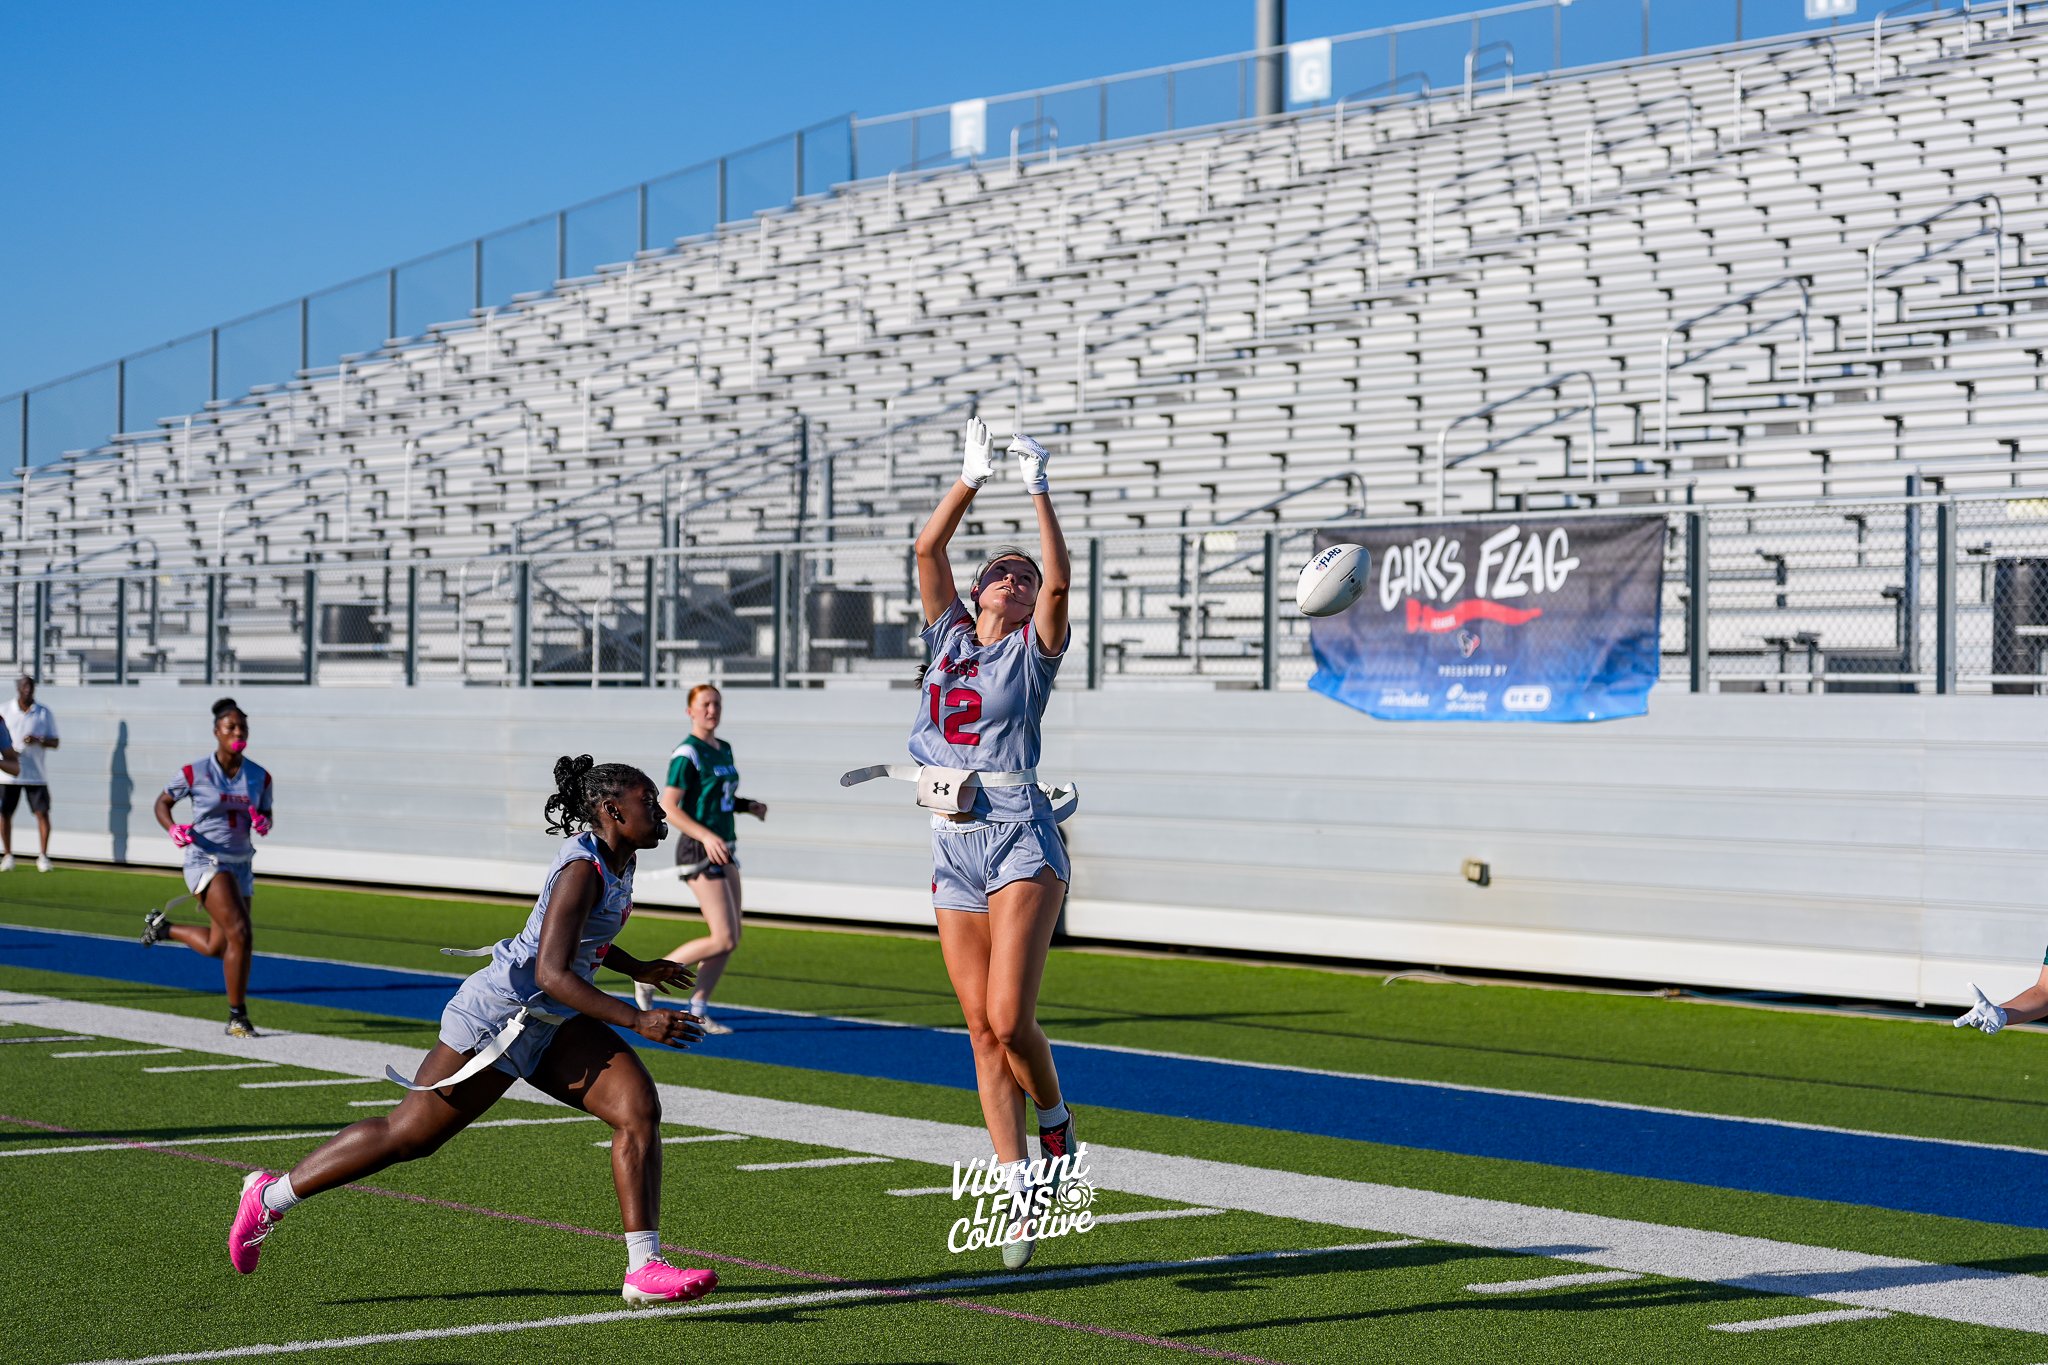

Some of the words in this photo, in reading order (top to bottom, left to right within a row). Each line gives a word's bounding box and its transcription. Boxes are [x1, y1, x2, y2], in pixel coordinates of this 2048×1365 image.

[1299, 59, 1323, 92] G
[1320, 548, 1342, 568] FLAG
[1379, 535, 1466, 612] GIRLS
[1475, 524, 1580, 599] FLAG
[1438, 664, 1491, 678] PRESENTED
[1494, 664, 1508, 678] BY
[929, 683, 982, 746] 12
